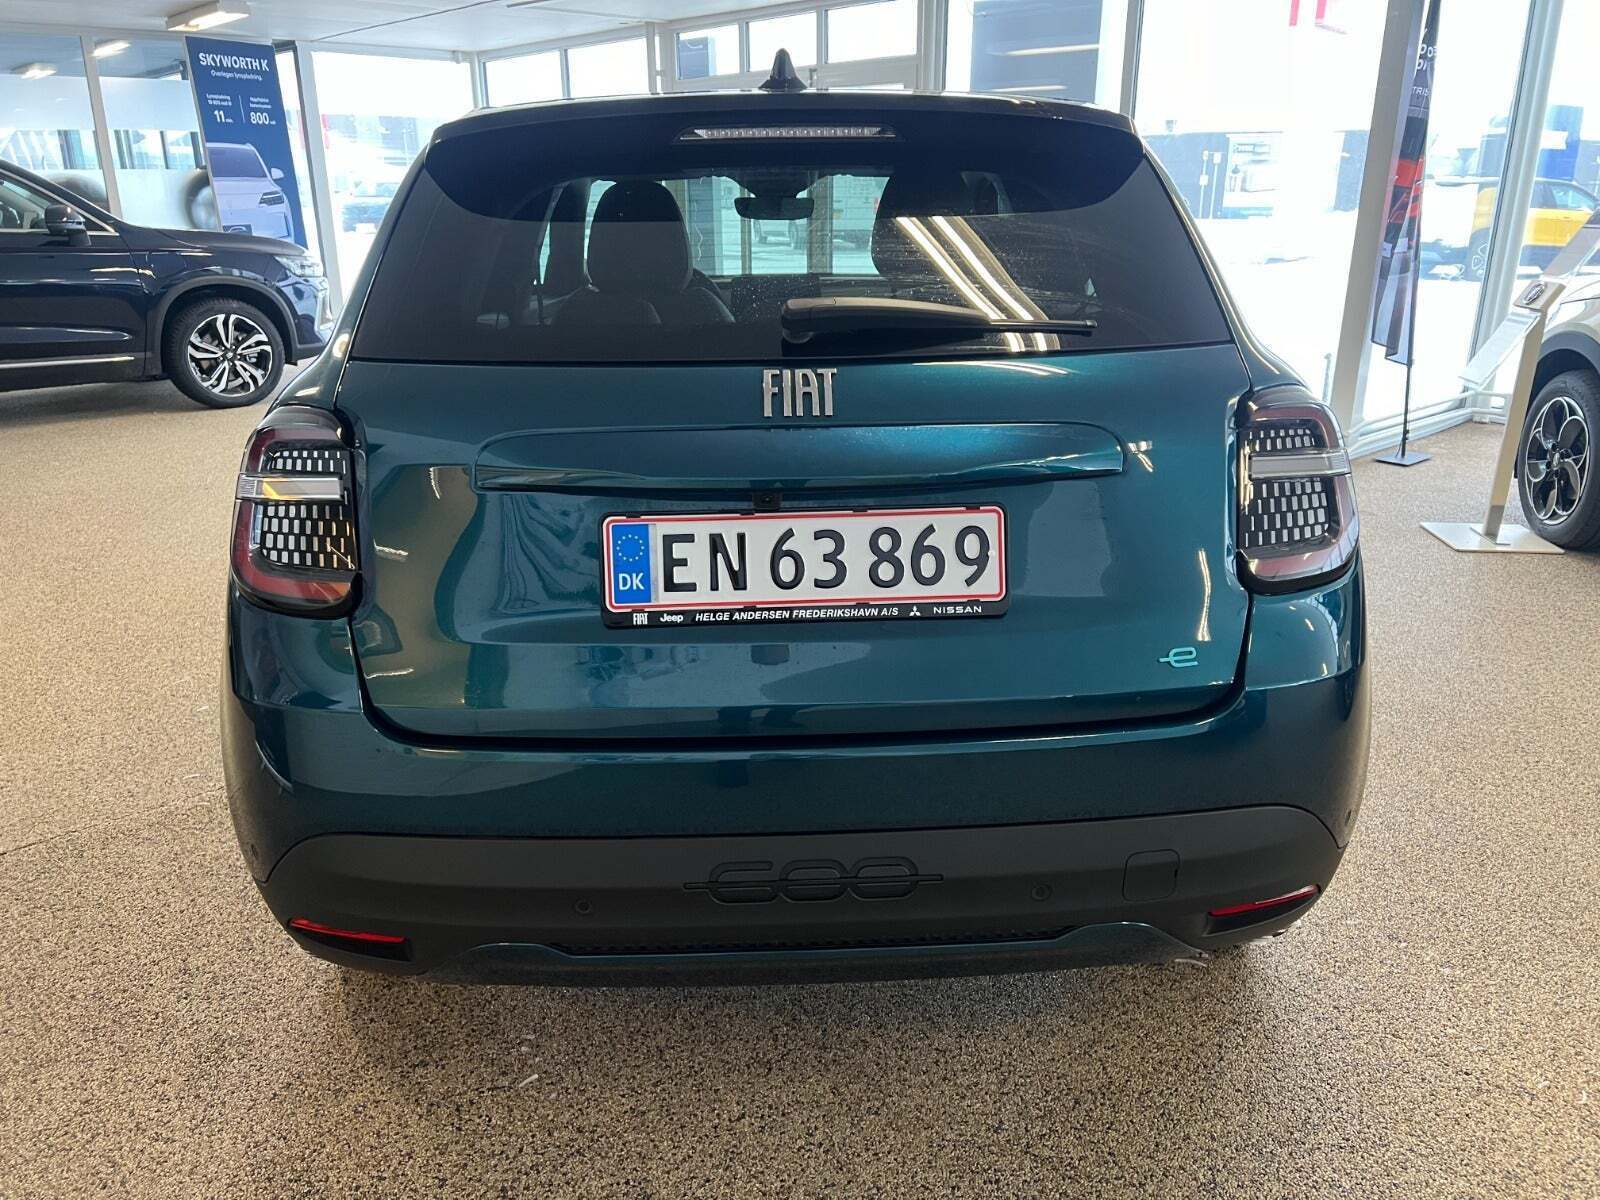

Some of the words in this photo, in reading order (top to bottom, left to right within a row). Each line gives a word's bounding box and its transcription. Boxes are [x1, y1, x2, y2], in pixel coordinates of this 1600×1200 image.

[199, 53, 260, 70] SKYWORTH
[262, 59, 270, 71] K
[214, 110, 225, 123] 11
[250, 112, 270, 124] 800
[763, 368, 837, 417] FIAT
[662, 532, 748, 593] EN
[769, 527, 848, 590] 63
[868, 523, 990, 588] 869
[618, 573, 644, 591] DK
[633, 612, 649, 625] FIAT
[660, 613, 684, 623] Jeep
[695, 612, 730, 622] HELGE
[732, 610, 790, 621] ANDERSEN
[792, 608, 879, 619] FREDERIKSHAVN
[881, 607, 899, 616] A/S
[933, 605, 982, 614] NISSAN
[684, 856, 944, 905] 600
